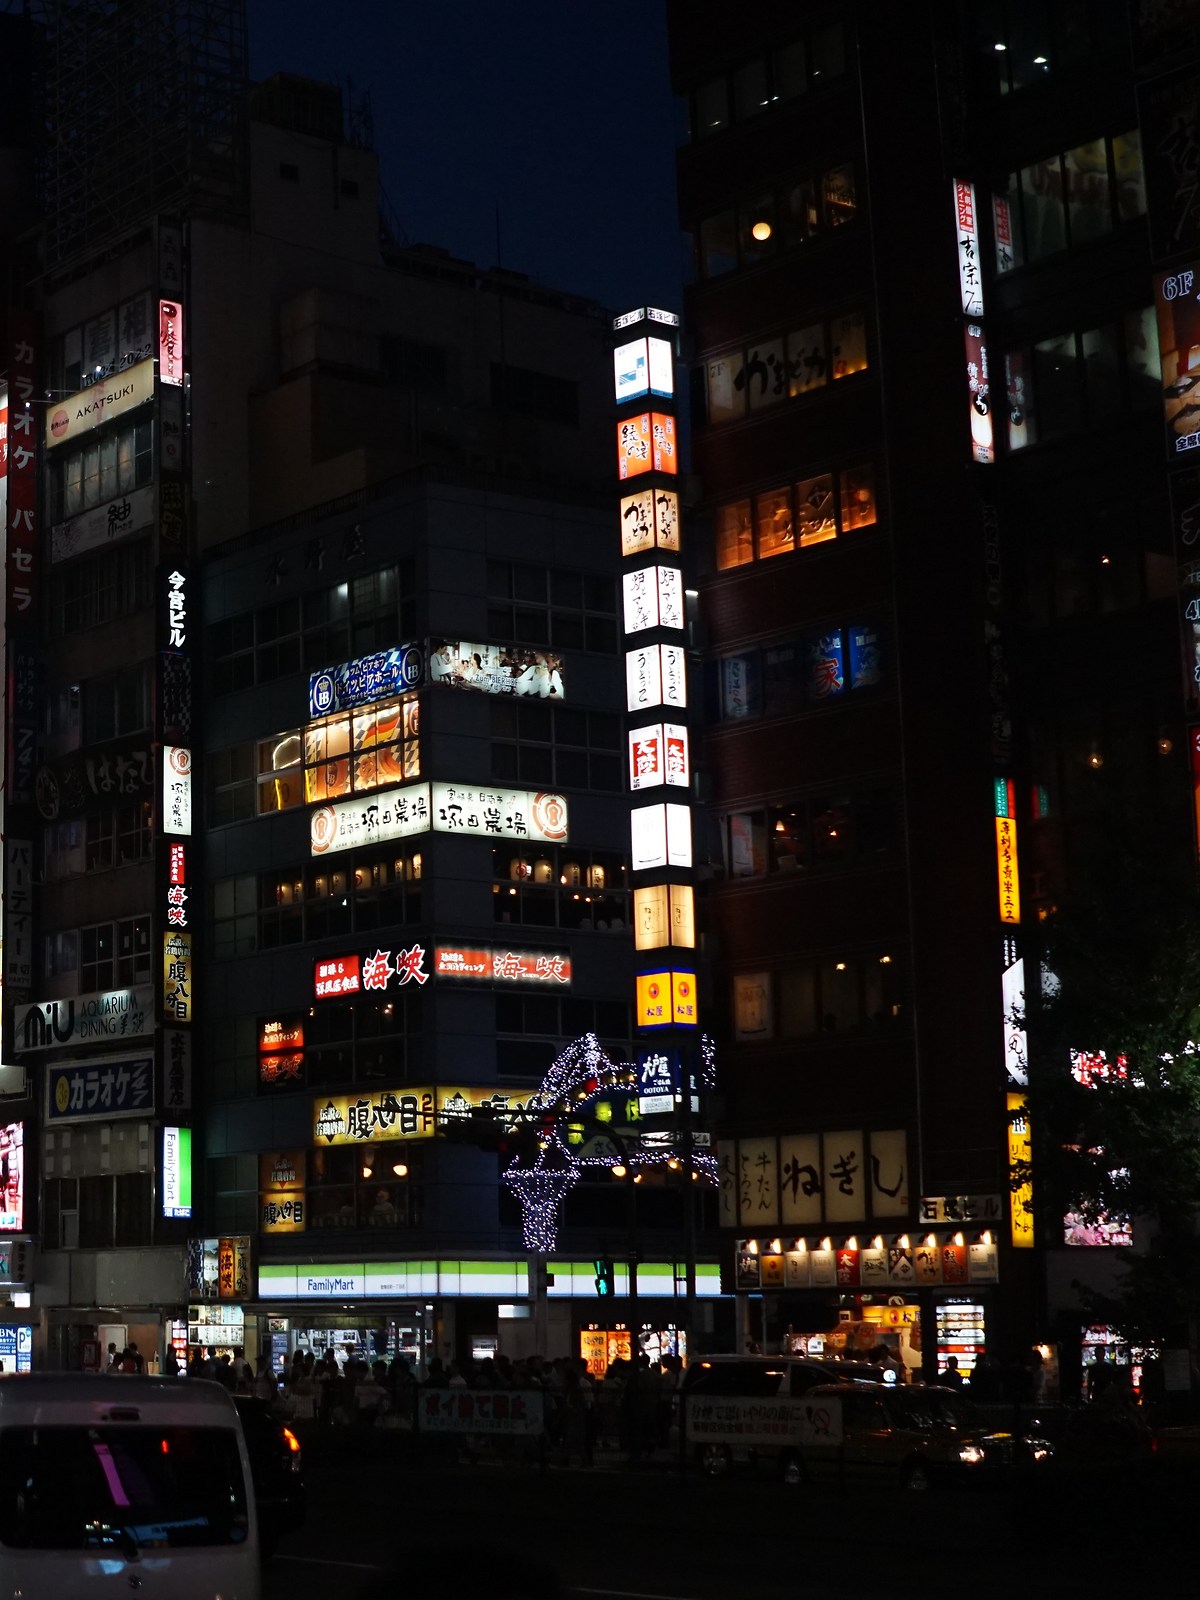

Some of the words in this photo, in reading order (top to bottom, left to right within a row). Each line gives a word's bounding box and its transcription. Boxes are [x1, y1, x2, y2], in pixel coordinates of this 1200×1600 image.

[1162, 270, 1194, 301] 6F
[613, 308, 644, 329] 石塚ビル
[648, 308, 678, 326] 石塚ビル
[12, 341, 35, 469] カラオケ
[75, 383, 135, 420] AKATSUKI
[1176, 432, 1200, 453] 全席
[336, 666, 400, 695] ドイツビアホール
[319, 691, 330, 706] HB
[637, 739, 657, 776] 大陸
[667, 742, 686, 774] 大陸
[361, 797, 428, 832] 塚田農場
[439, 804, 527, 835] 塚田農場
[167, 885, 188, 927] 海峡
[362, 943, 430, 991] 海峡
[492, 952, 569, 983] 海峡
[166, 960, 191, 1019] 腹八分目
[80, 994, 139, 1018] AQUARIUM
[646, 1005, 663, 1017] 松屋
[676, 1004, 693, 1016] 松屋
[80, 1018, 117, 1038] DINING
[69, 1069, 131, 1111] カラオケ
[643, 1086, 669, 1094] OOTOYA
[164, 1132, 176, 1201] FamilyMart
[739, 1152, 753, 1210] とろろ
[755, 1150, 773, 1211] 牛たん
[780, 1150, 904, 1205] ねぎし
[263, 1200, 304, 1225] 腹八分目
[307, 1277, 355, 1295] FamilyMart
